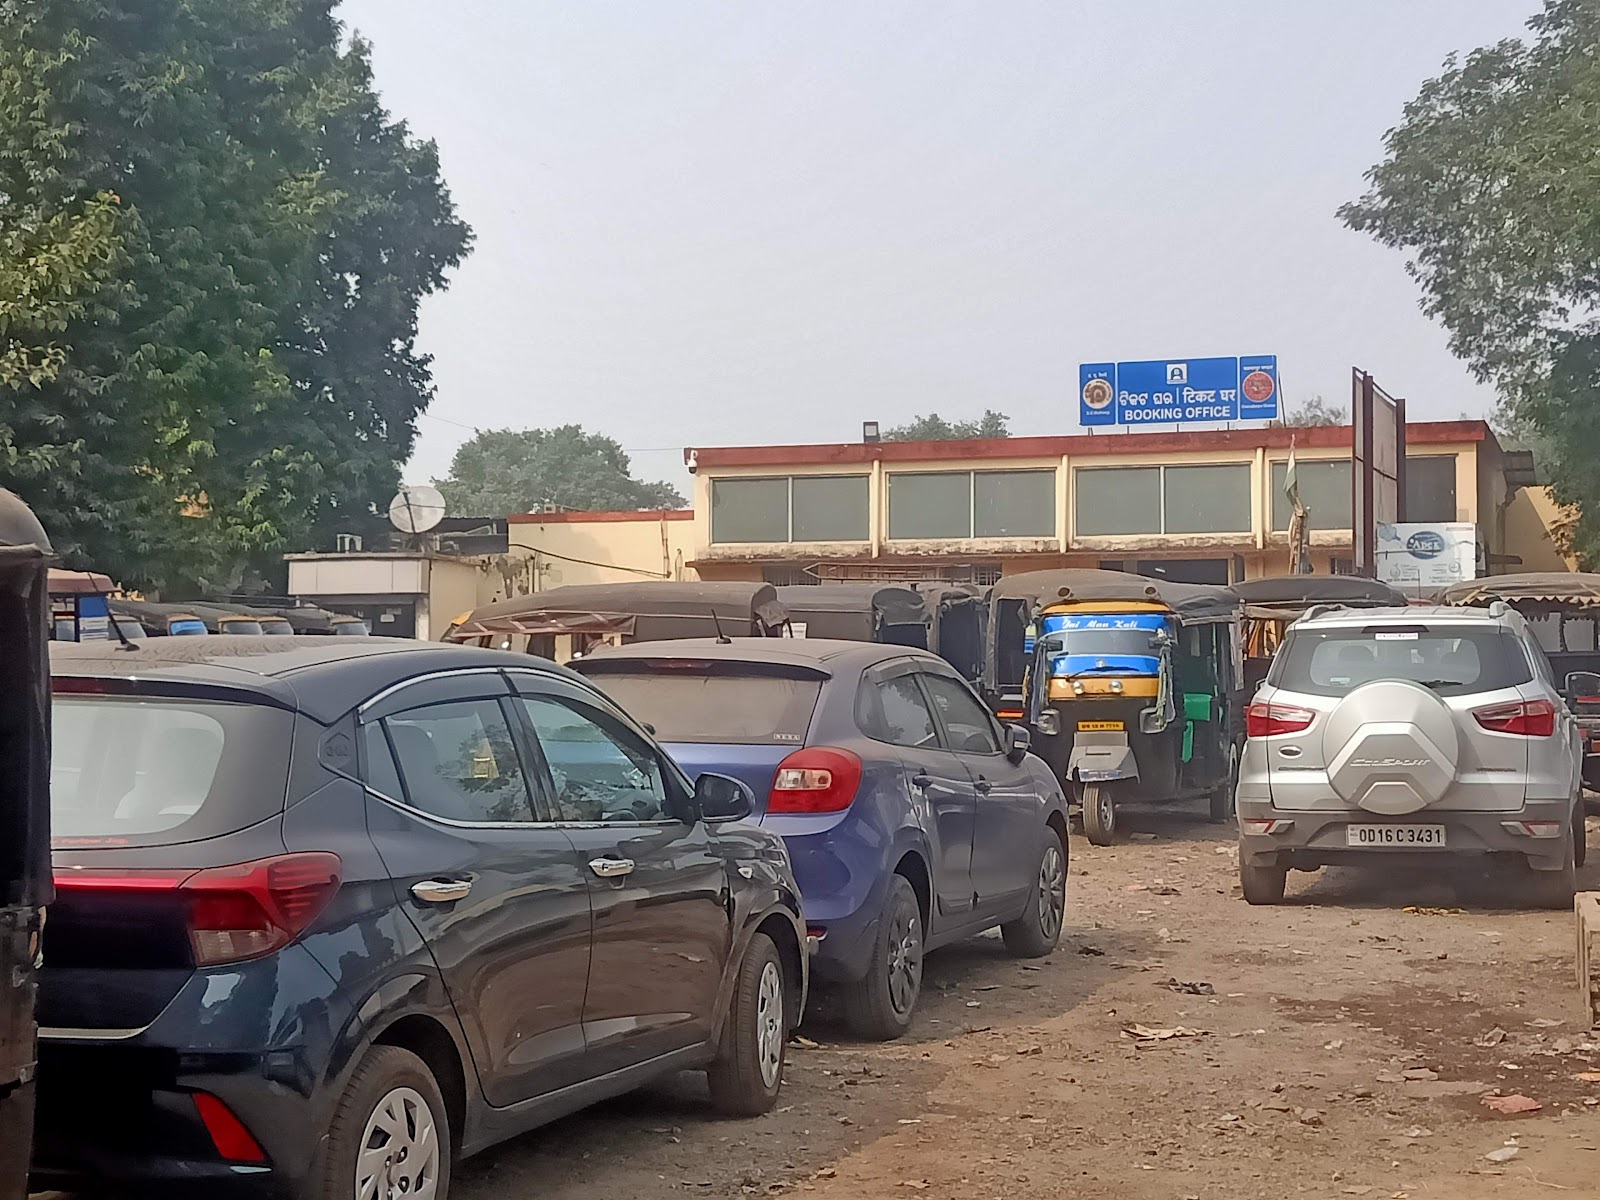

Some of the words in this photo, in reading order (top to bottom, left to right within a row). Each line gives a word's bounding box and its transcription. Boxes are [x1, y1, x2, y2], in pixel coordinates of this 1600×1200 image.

[1182, 386, 1216, 403] टिकट
[1219, 389, 1236, 402] घर
[1124, 407, 1182, 421] BOOKING
[1185, 405, 1230, 419] OFFICE
[1396, 829, 1404, 842] C
[1407, 828, 1440, 843] 3431
